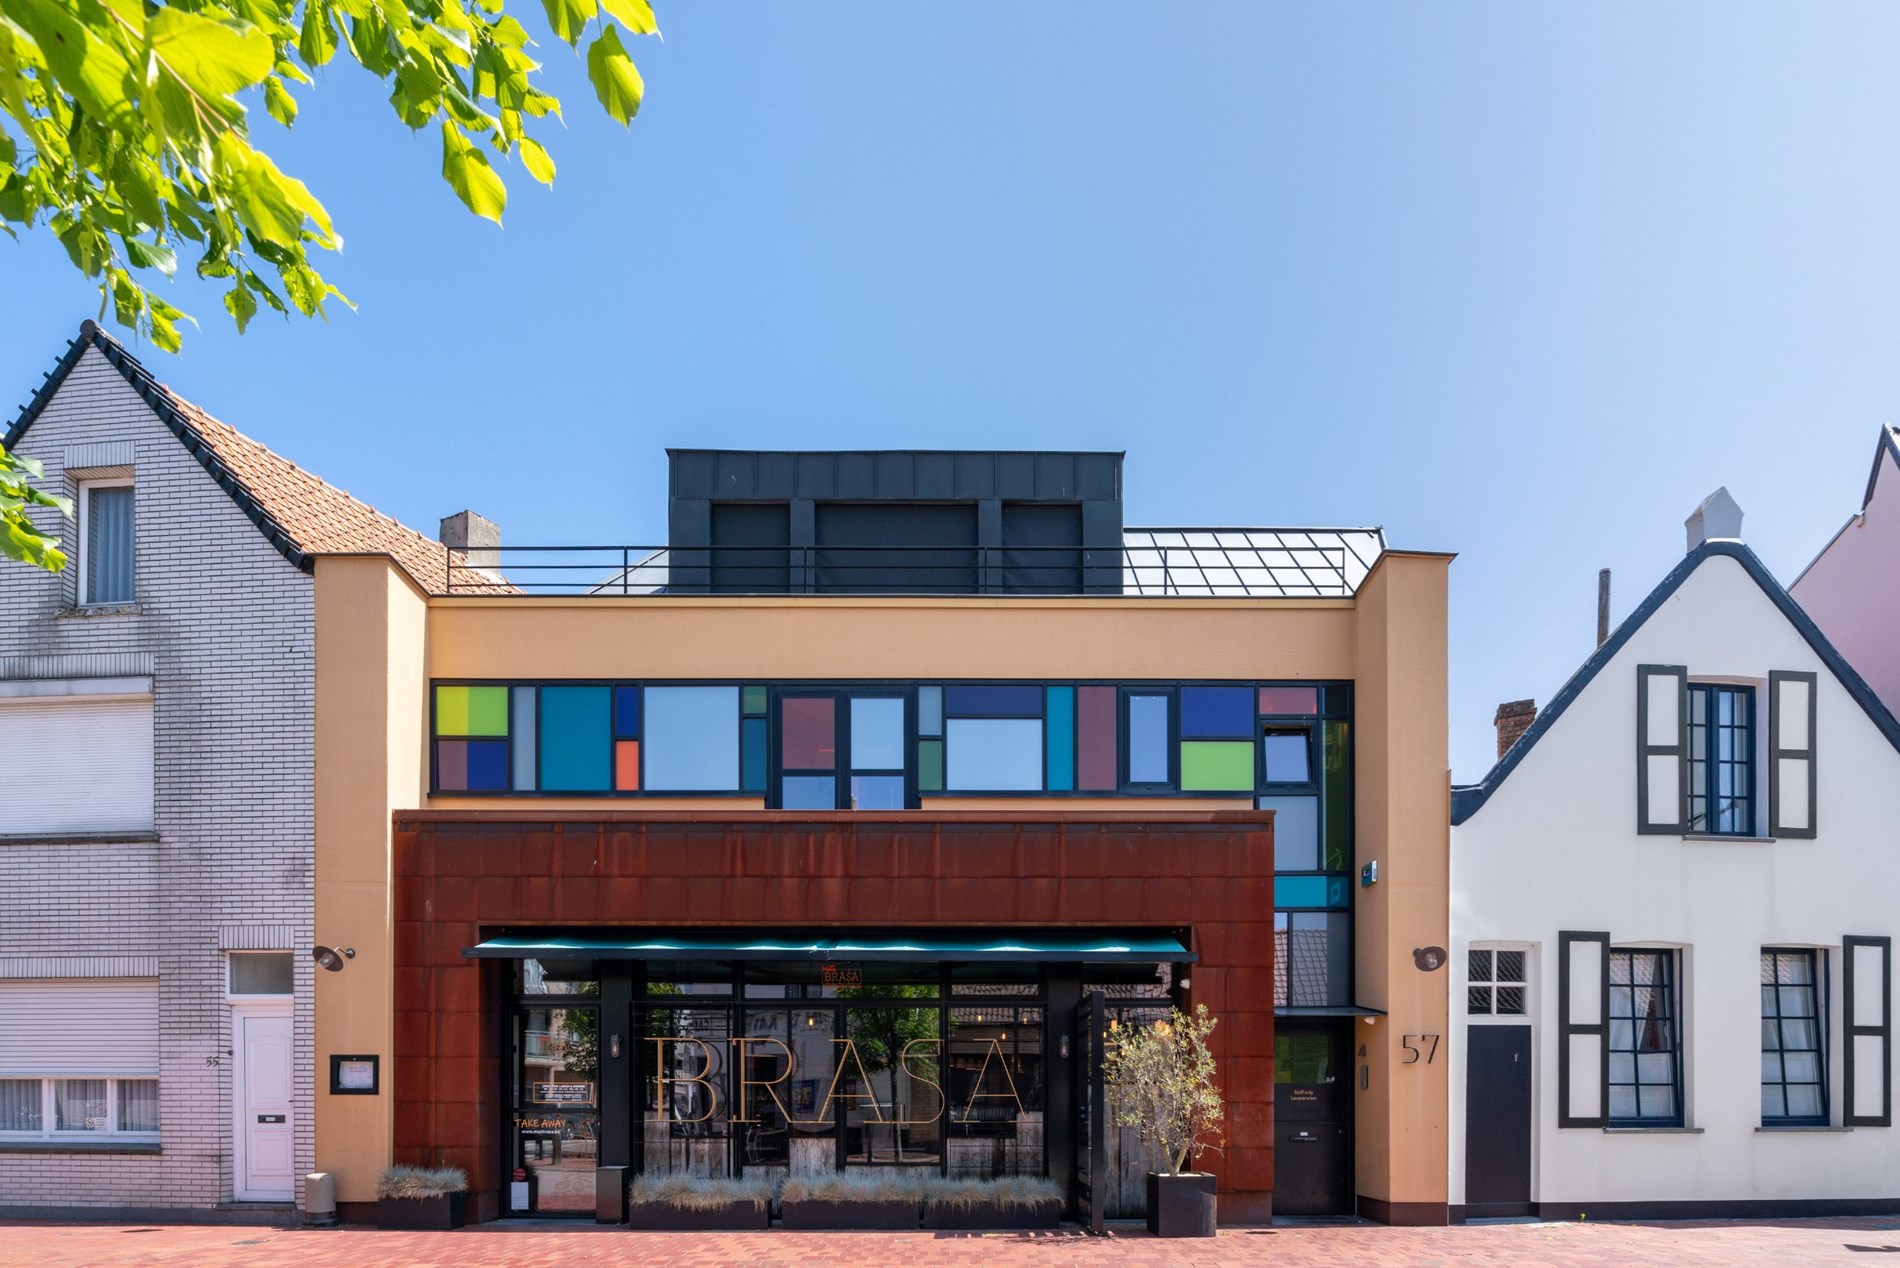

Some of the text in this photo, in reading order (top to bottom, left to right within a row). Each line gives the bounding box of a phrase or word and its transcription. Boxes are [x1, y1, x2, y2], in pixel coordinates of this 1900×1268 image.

[824, 972, 859, 982] BRASA
[1402, 1035, 1440, 1064] 57
[206, 1056, 219, 1067] 55
[644, 1037, 1030, 1124] BRASA
[514, 1118, 566, 1128] TAKE AWAY
